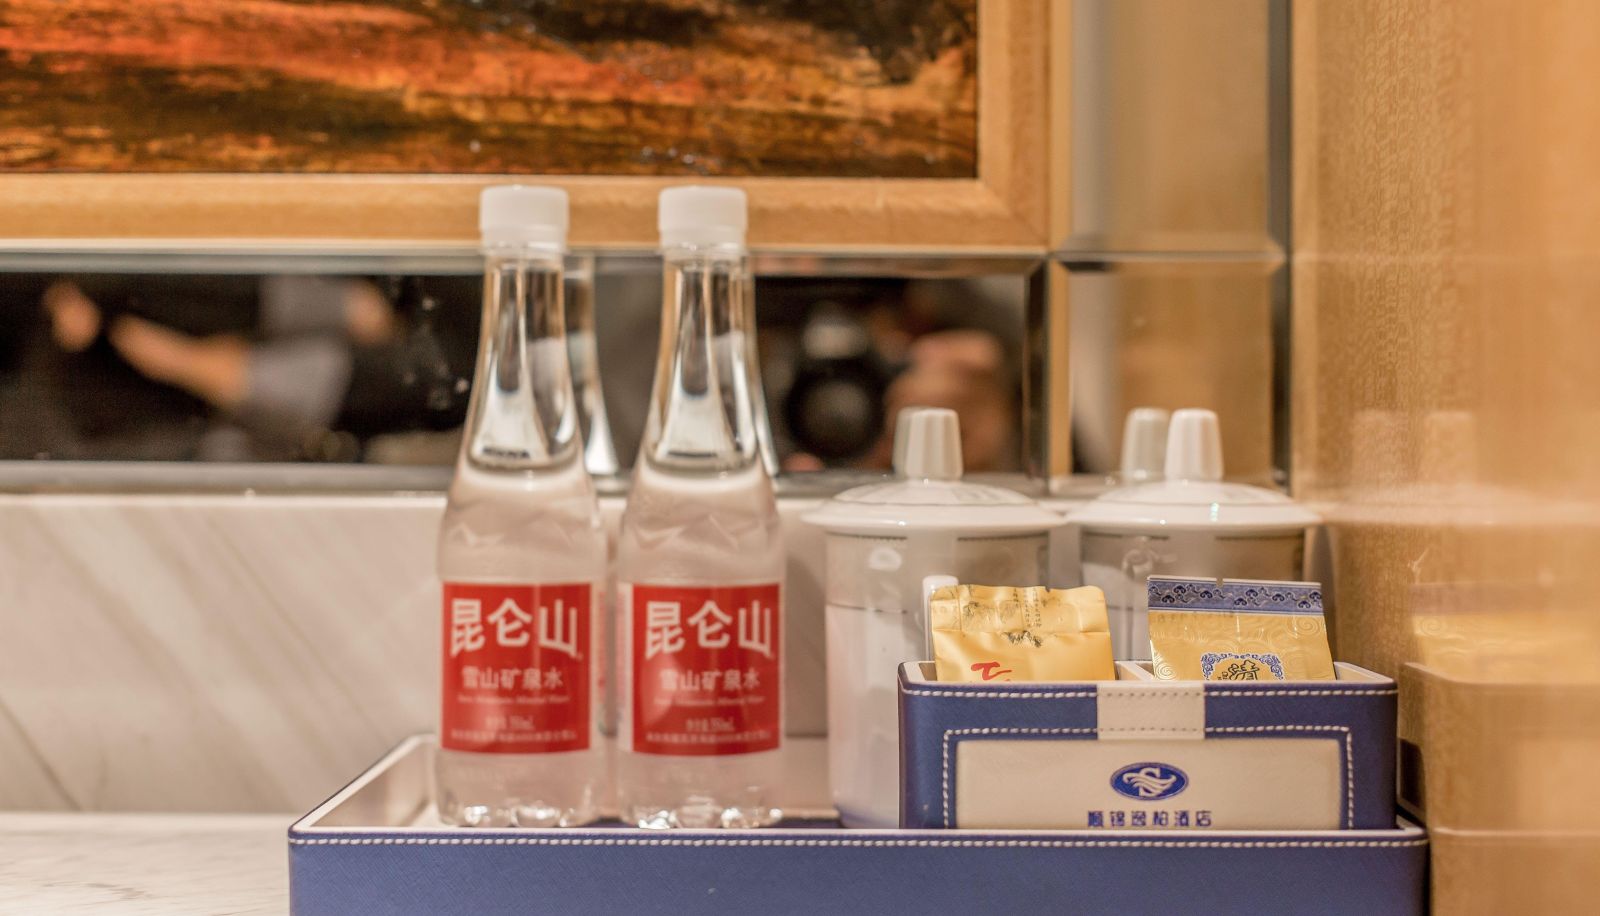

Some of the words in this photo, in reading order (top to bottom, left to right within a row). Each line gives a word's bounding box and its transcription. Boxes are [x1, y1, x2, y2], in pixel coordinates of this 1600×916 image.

[451, 598, 578, 658] 昆仑山
[645, 600, 772, 660] 昆仑山
[462, 666, 563, 690] 雪山矿泉水
[660, 668, 760, 691] 雪山矿泉水
